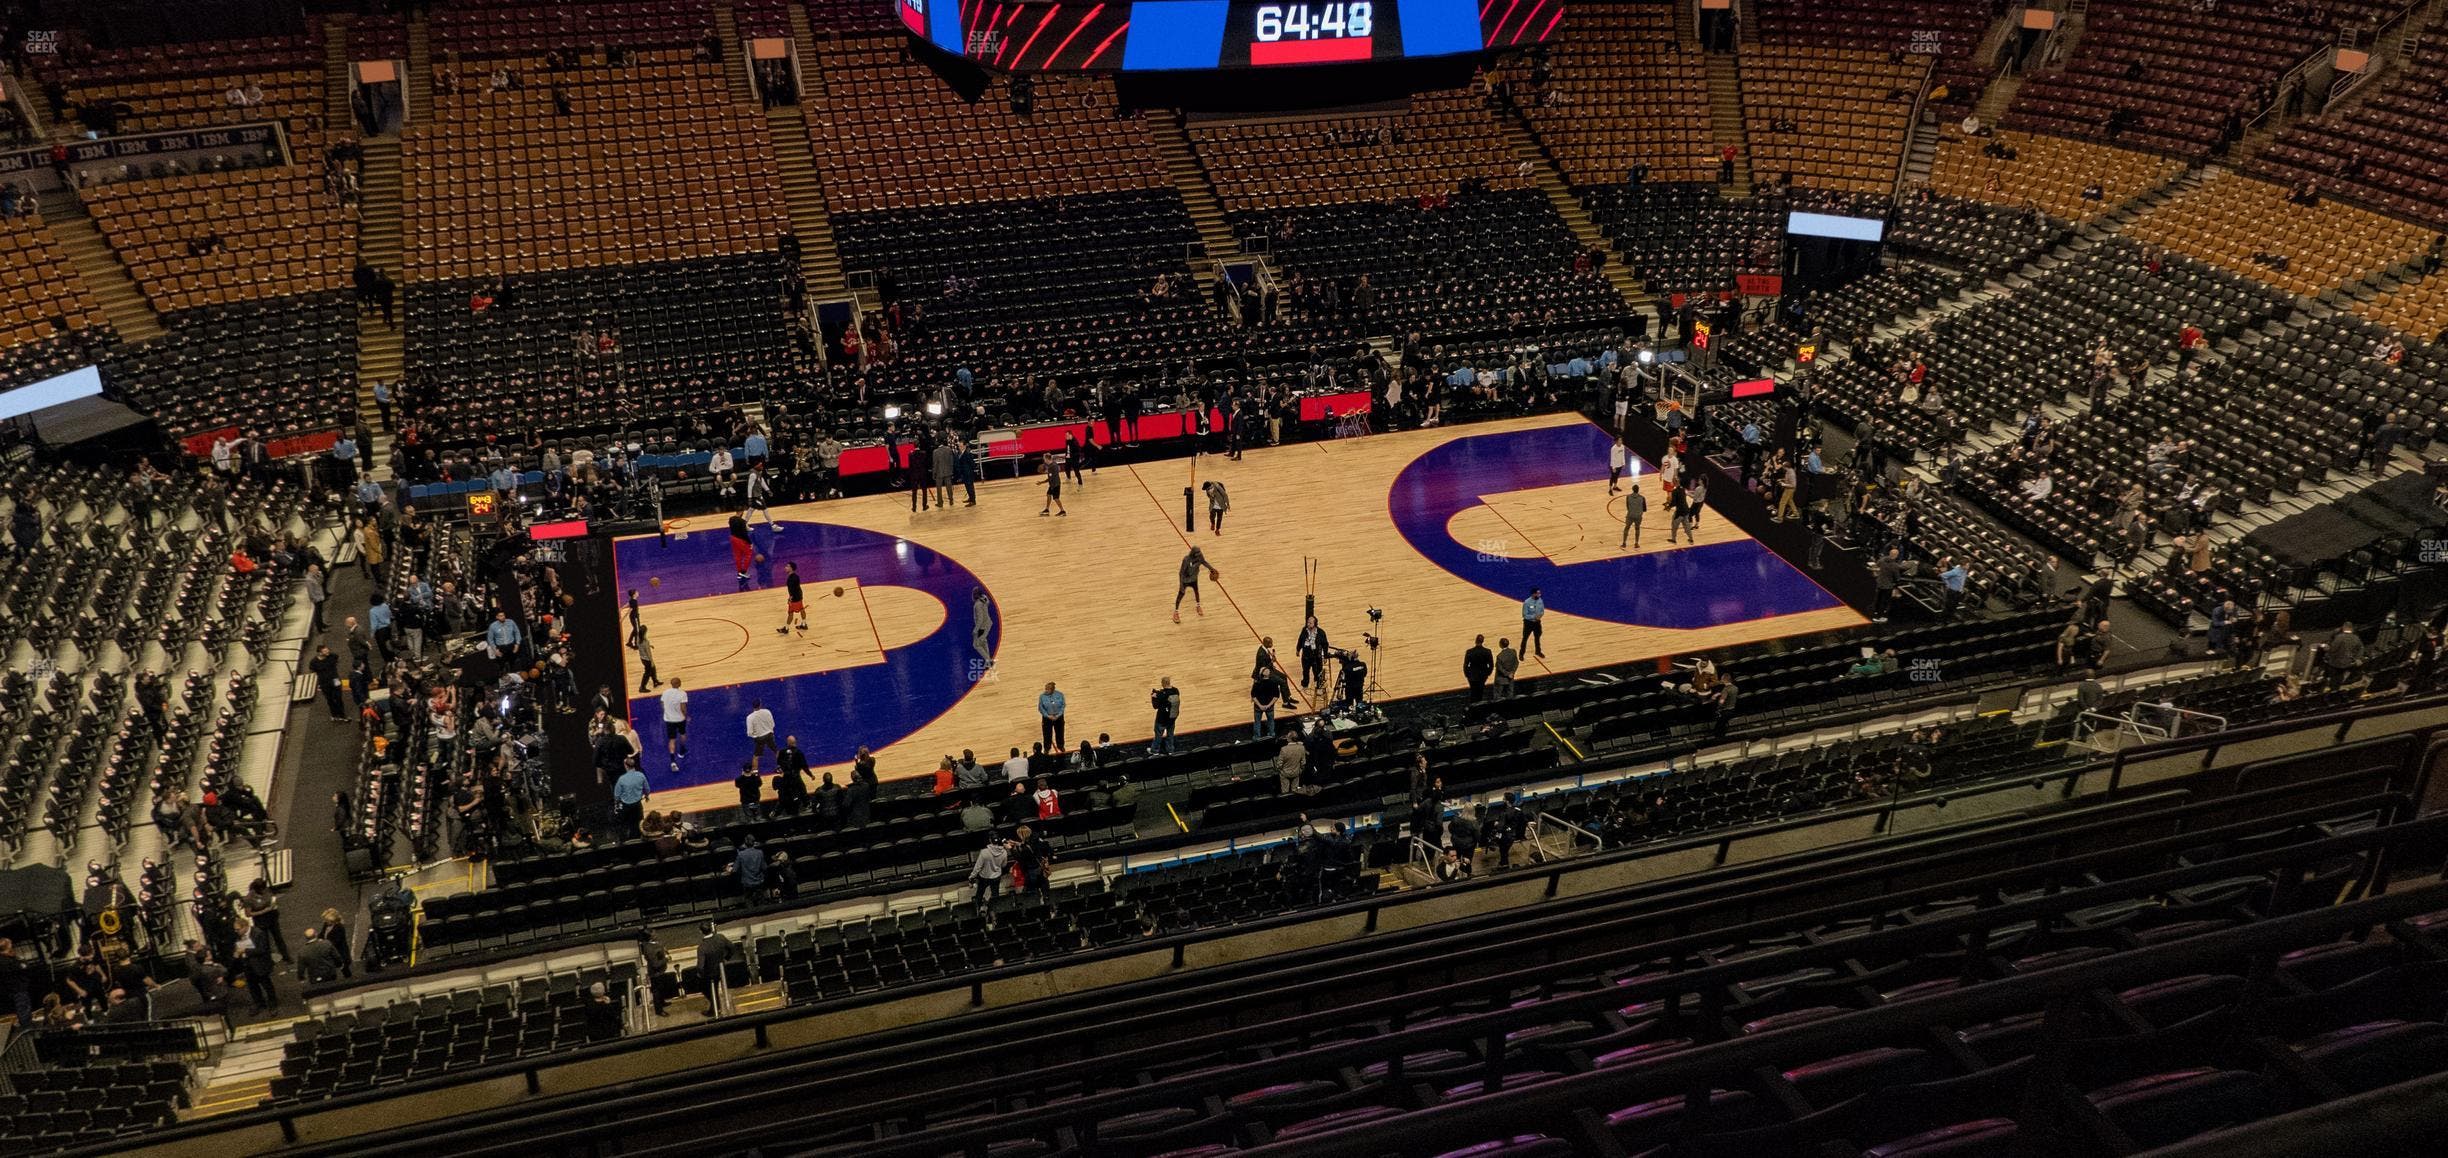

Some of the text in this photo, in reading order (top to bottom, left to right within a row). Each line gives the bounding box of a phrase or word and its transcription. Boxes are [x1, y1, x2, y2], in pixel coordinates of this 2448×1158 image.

[0, 156, 25, 170] BM
[78, 143, 108, 160] IBM
[119, 140, 149, 155] IBM
[161, 136, 190, 150] IBM
[202, 132, 230, 146] IBM
[241, 128, 268, 142] IBM
[474, 503, 488, 513] 24
[1046, 801, 1053, 813] 7
